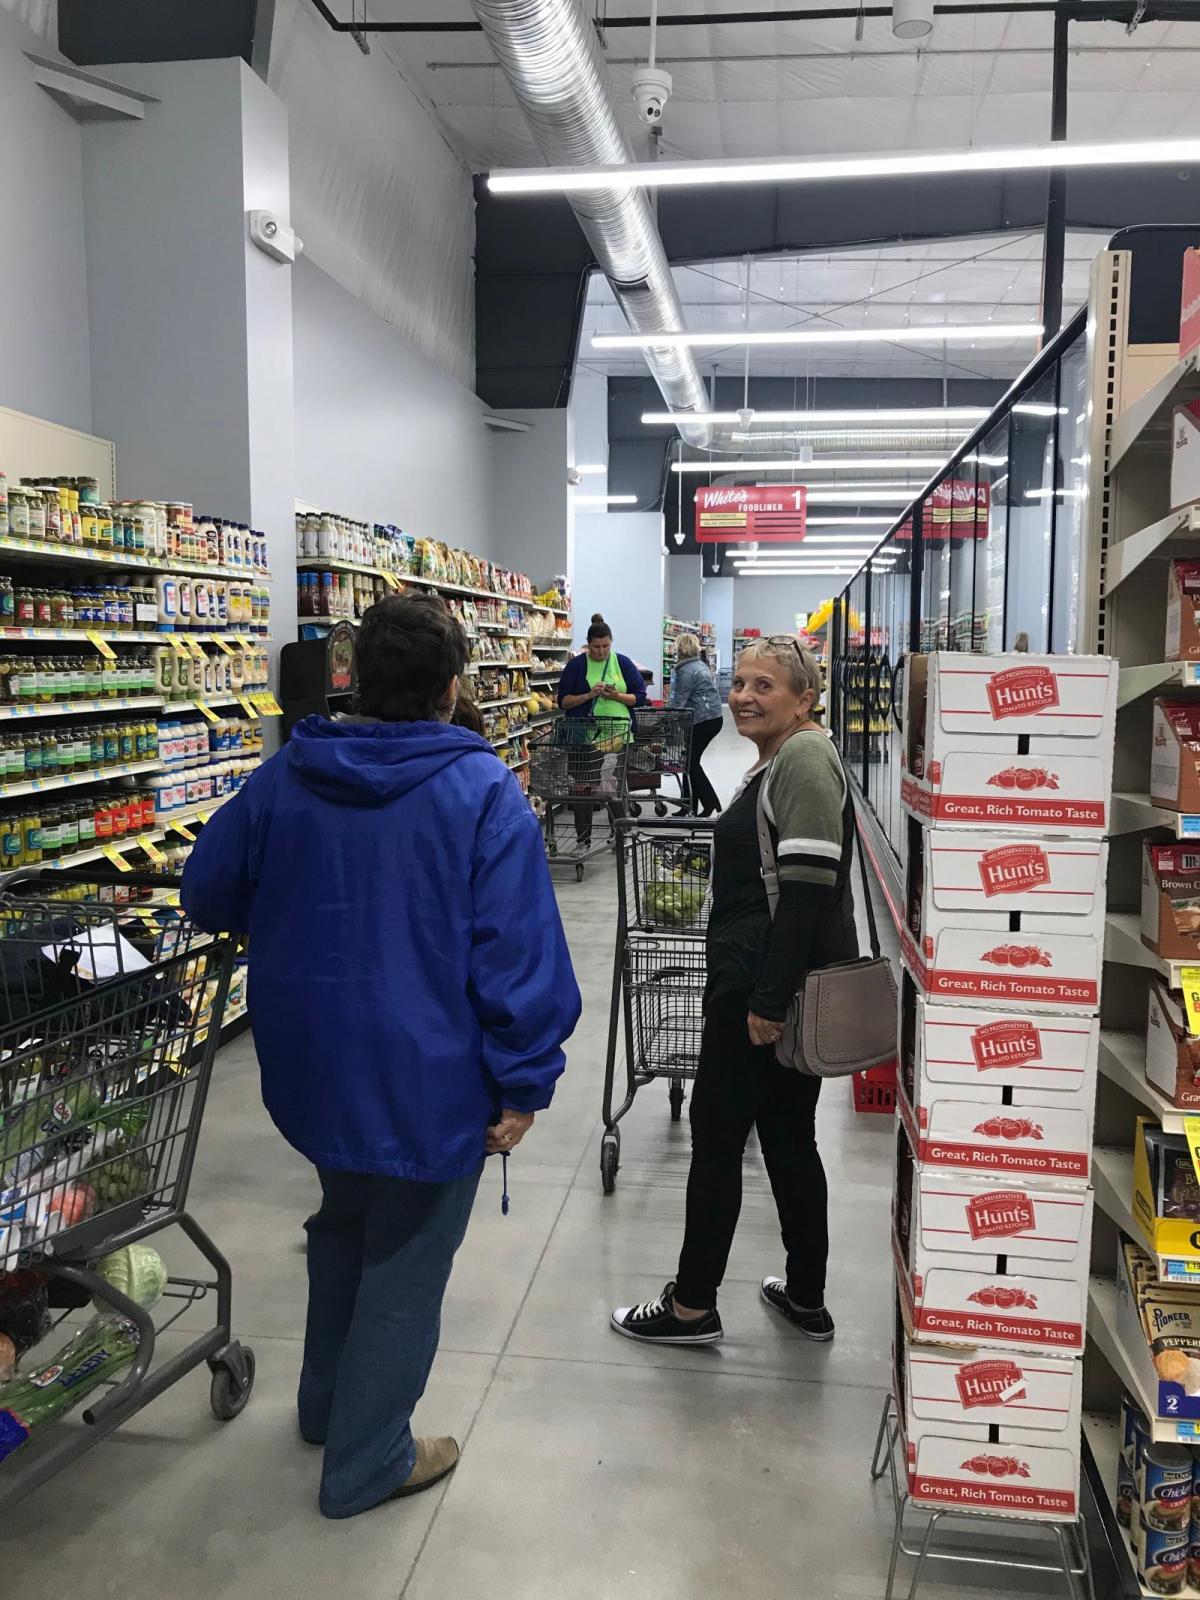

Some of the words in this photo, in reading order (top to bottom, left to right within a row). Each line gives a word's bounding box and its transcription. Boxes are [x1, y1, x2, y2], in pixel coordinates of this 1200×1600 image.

[704, 490, 749, 509] White's
[738, 503, 783, 512] FOODLINER
[791, 490, 801, 510] 1
[995, 675, 1006, 683] NO
[1006, 668, 1047, 679] PRESERVATIVES
[995, 681, 1053, 706] Hunt's
[1000, 702, 1026, 714] TOMATO
[1027, 697, 1053, 708] KETCHUP
[944, 803, 984, 816] Great,
[986, 804, 1013, 816] Rich
[1015, 806, 1063, 818] Tomato
[1065, 808, 1098, 819] Taste
[997, 847, 1037, 857] PRESERVATIVES
[988, 860, 1045, 885] Hunt's
[991, 880, 1018, 891] TOMATO
[1019, 875, 1044, 885] KETCHUP
[1161, 879, 1192, 889] Brown
[938, 977, 977, 991] Great,
[980, 979, 1006, 991] Rich
[1008, 982, 1055, 995] Tomato
[1057, 985, 1090, 997] Taste
[989, 1022, 1030, 1033] PRESERVATIVES
[980, 1036, 1036, 1059] Hunt's
[983, 1055, 1010, 1065] TOMATO
[1010, 1051, 1036, 1060] KETCHUP
[931, 1148, 969, 1162] Great,
[972, 1151, 998, 1163] Rich
[1000, 1153, 1047, 1167] Tomato
[1049, 1157, 1081, 1170] Taste
[983, 1192, 1023, 1203] PRESERVATIVES
[974, 1206, 1030, 1228] Hunt's
[978, 1224, 1004, 1234] TOMATO
[1004, 1221, 1029, 1230] KETCHUP
[926, 1315, 964, 1330] Great,
[967, 1319, 992, 1331] Rich
[994, 1322, 1041, 1337] Tomato
[1042, 1327, 1076, 1341] Taste
[1162, 1338, 1200, 1347] PEPPER
[973, 1362, 1013, 1372] PRESERVATIVES
[965, 1376, 1018, 1396] Hunt's
[969, 1393, 995, 1404] TOMATO
[1167, 1397, 1178, 1411] 2
[920, 1483, 958, 1497] Great,
[960, 1487, 987, 1500] Rich
[988, 1490, 1034, 1504] Tomato
[1036, 1495, 1068, 1508] Taste
